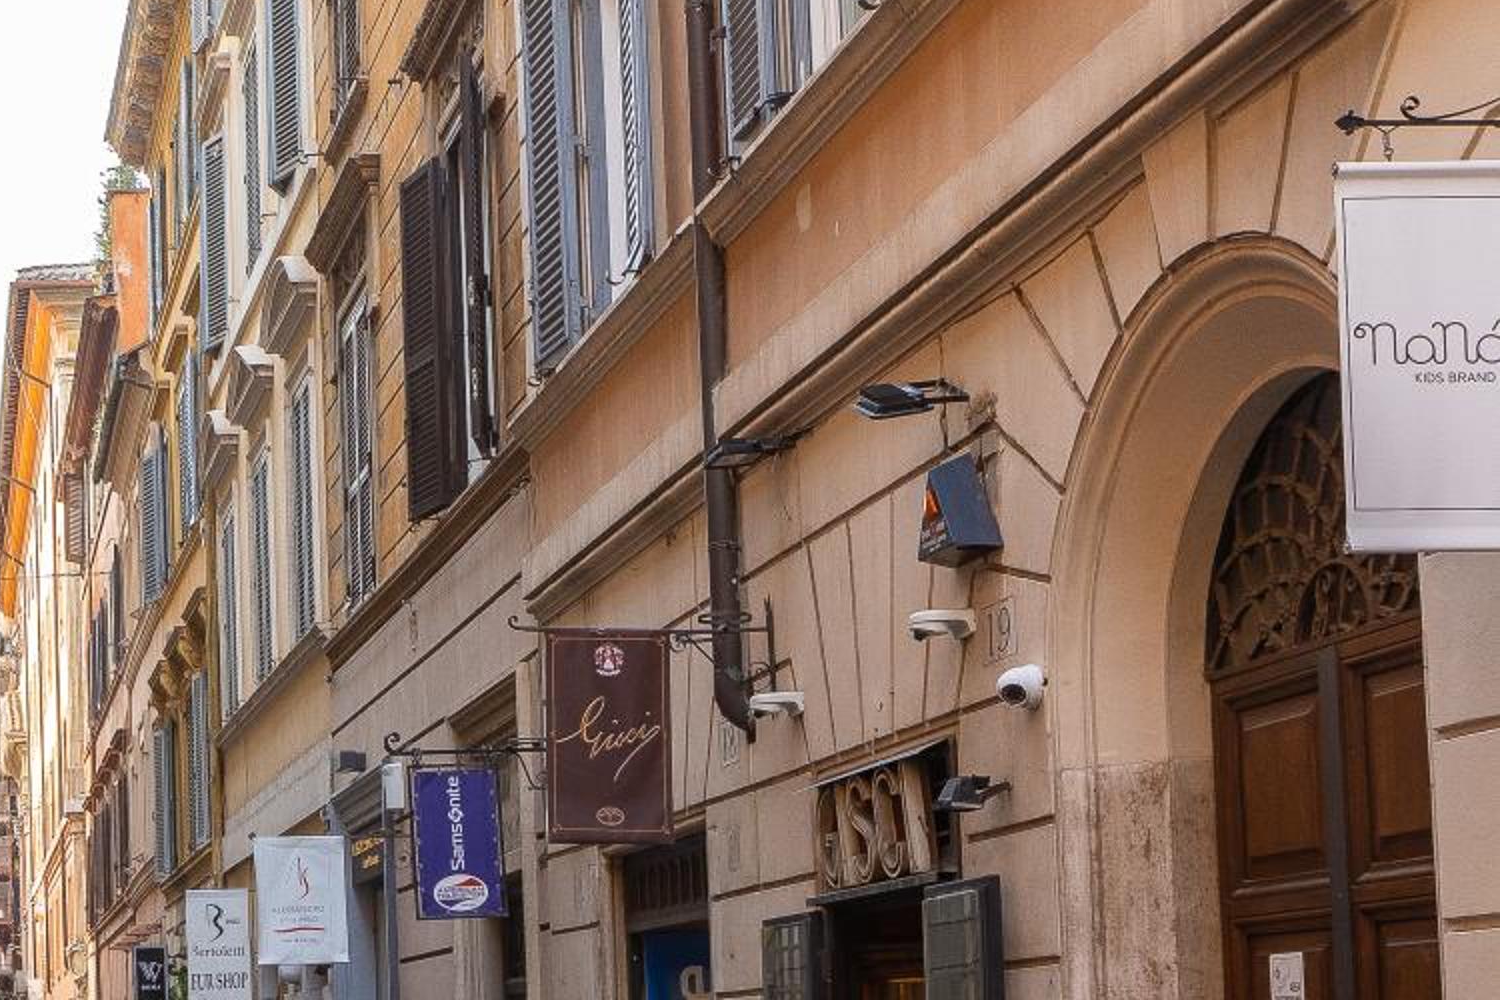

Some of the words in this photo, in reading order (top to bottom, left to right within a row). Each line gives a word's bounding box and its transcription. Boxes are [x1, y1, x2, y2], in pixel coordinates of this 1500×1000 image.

[1415, 371, 1445, 383] KIDS
[1448, 371, 1497, 383] BRAND
[988, 605, 1012, 658] 19
[446, 775, 465, 871] Samsonite
[191, 973, 214, 991] FUR
[216, 971, 249, 990] SHOP
